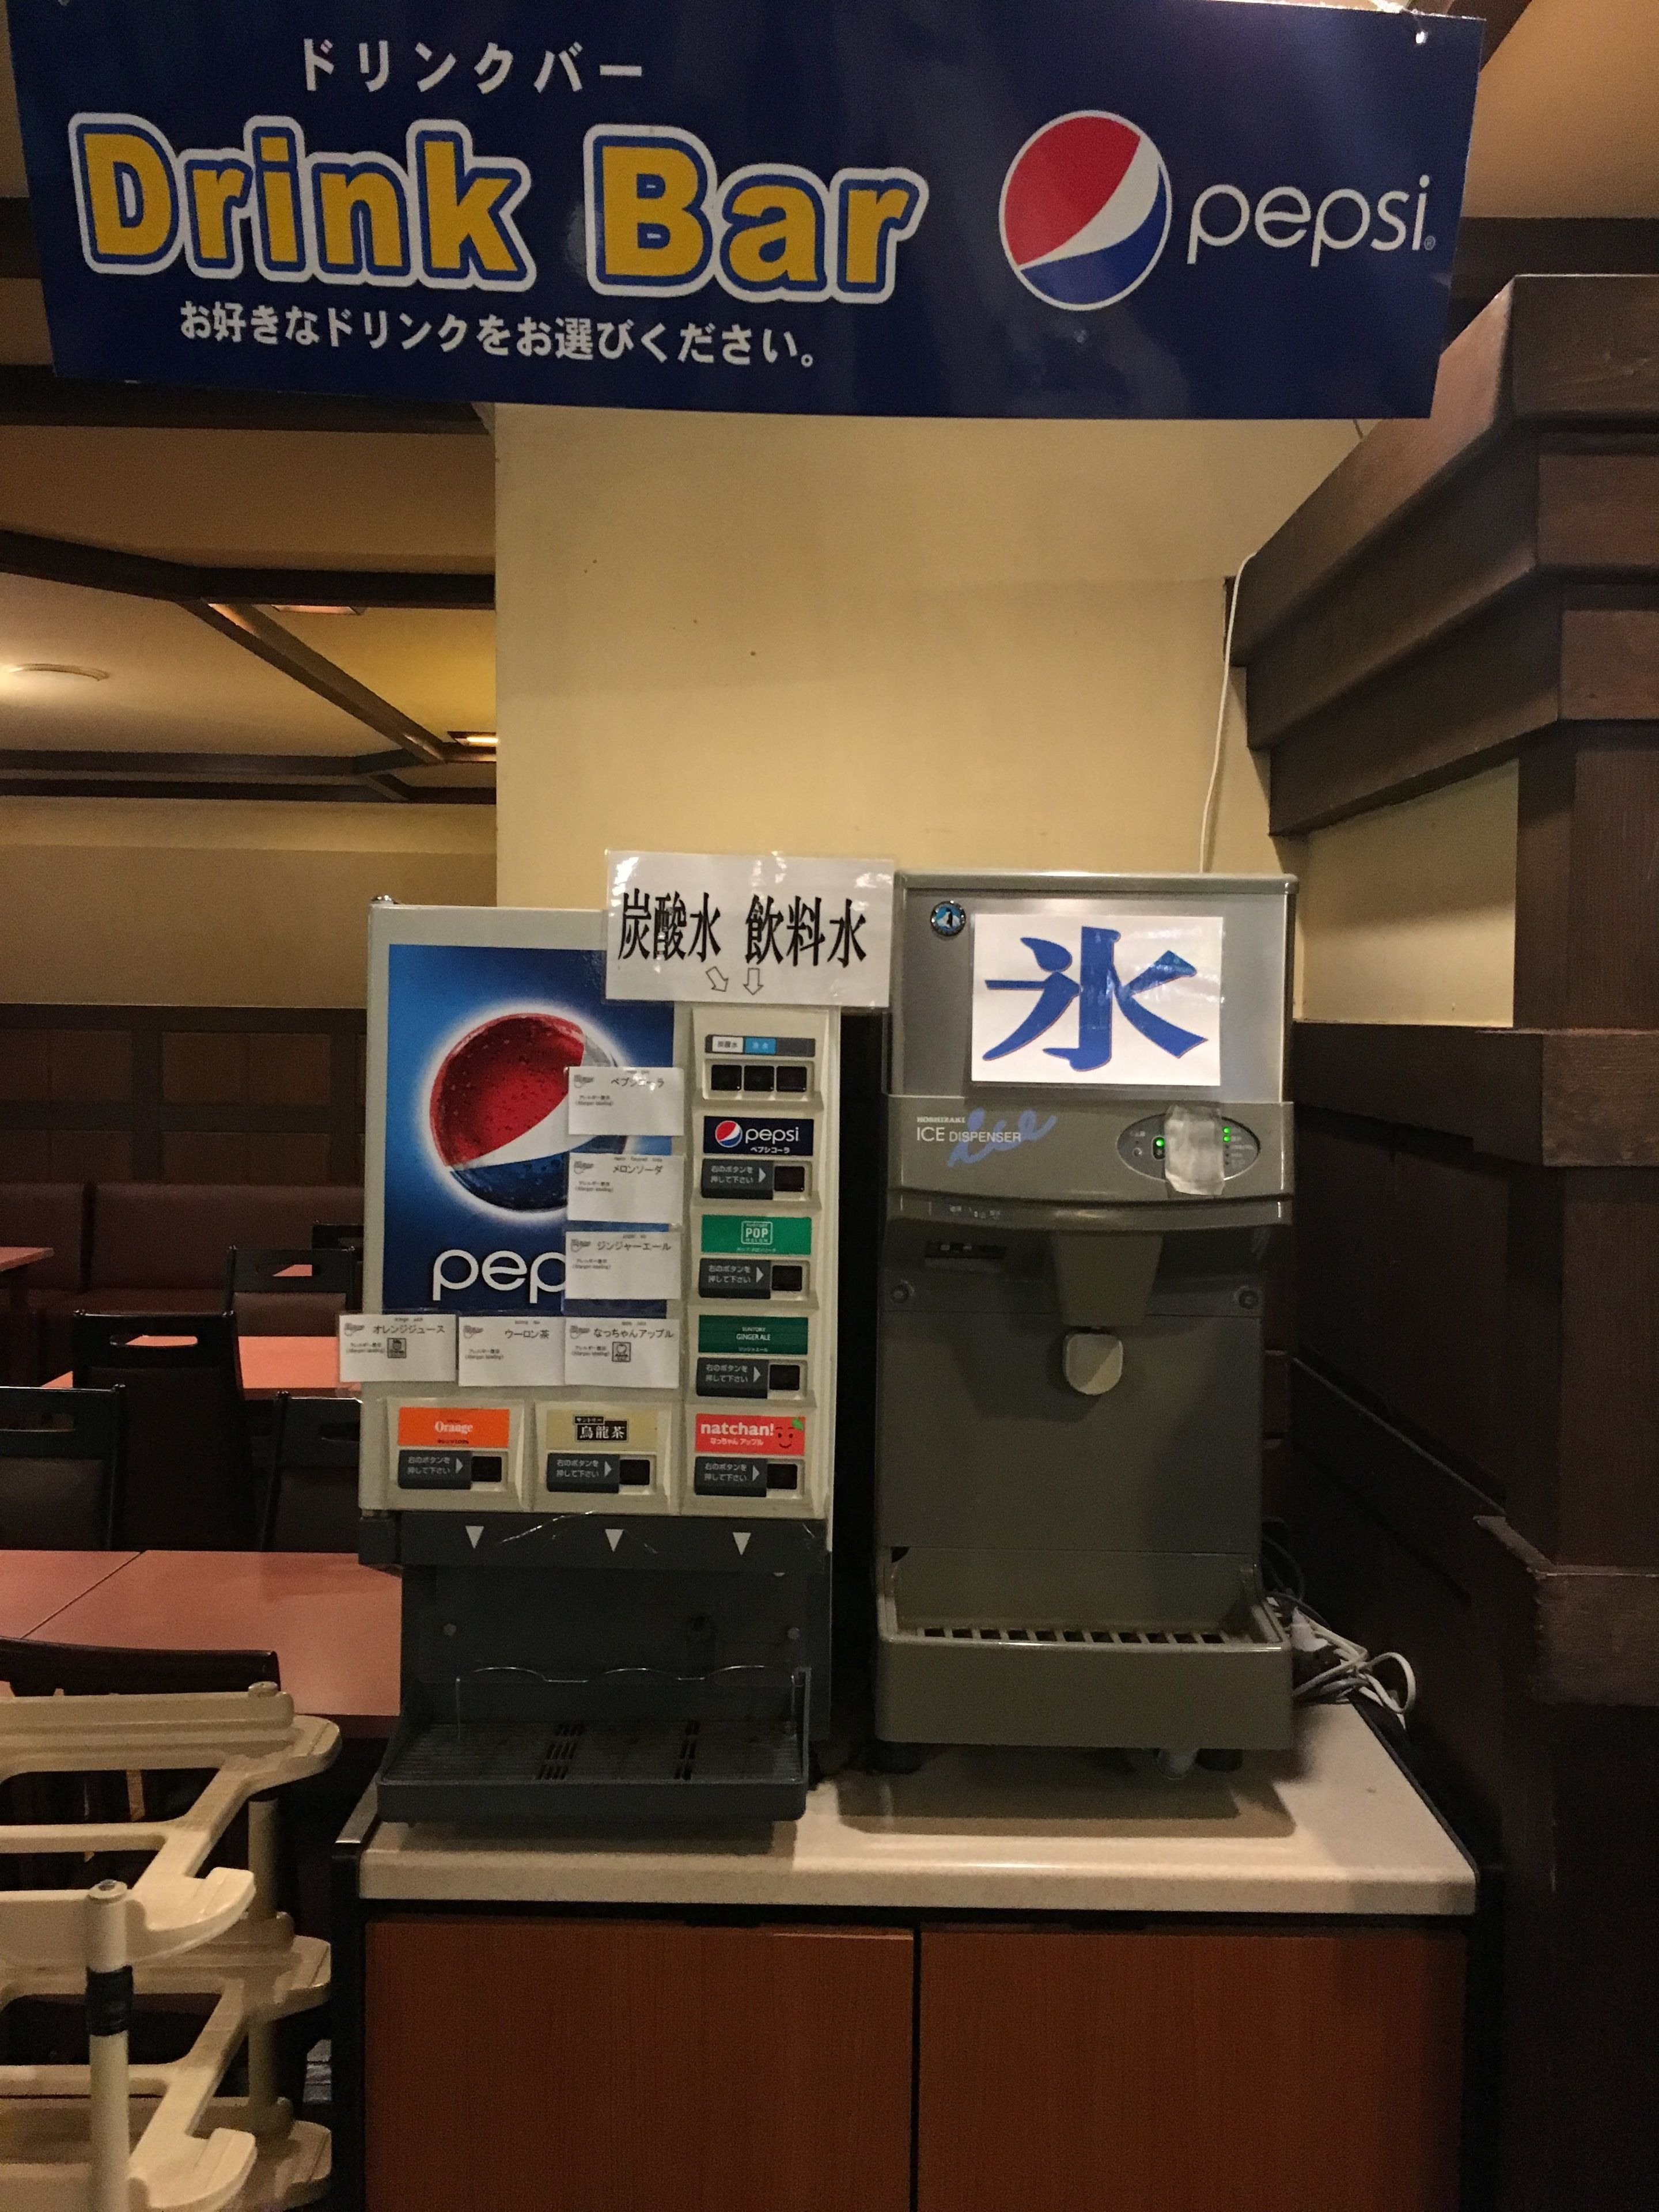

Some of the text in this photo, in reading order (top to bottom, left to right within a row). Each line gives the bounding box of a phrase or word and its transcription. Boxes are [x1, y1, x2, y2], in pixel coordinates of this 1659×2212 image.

[304, 37, 643, 94] ドリンクバー
[68, 112, 930, 304] Drink Bar
[1187, 174, 1431, 267] pepsi
[179, 300, 814, 368] お好きなドリンクをお選びください。
[618, 888, 867, 968] 炭酸水 飲料水
[982, 926, 1209, 1072] 氷
[745, 1127, 800, 1144] pepsi
[916, 1127, 1021, 1143] ICE DISPENSER
[612, 1165, 664, 1175] メロンソーダ
[745, 1228, 768, 1238] POP
[597, 1241, 672, 1252] ジンジャーエール
[432, 1249, 565, 1304] pep
[372, 1324, 445, 1335] オレンジジュース
[505, 1329, 550, 1339] ウーロン茶
[593, 1328, 674, 1339] なっちゃんアップル
[434, 1420, 474, 1435] Orange
[700, 1422, 775, 1437] natchan!
